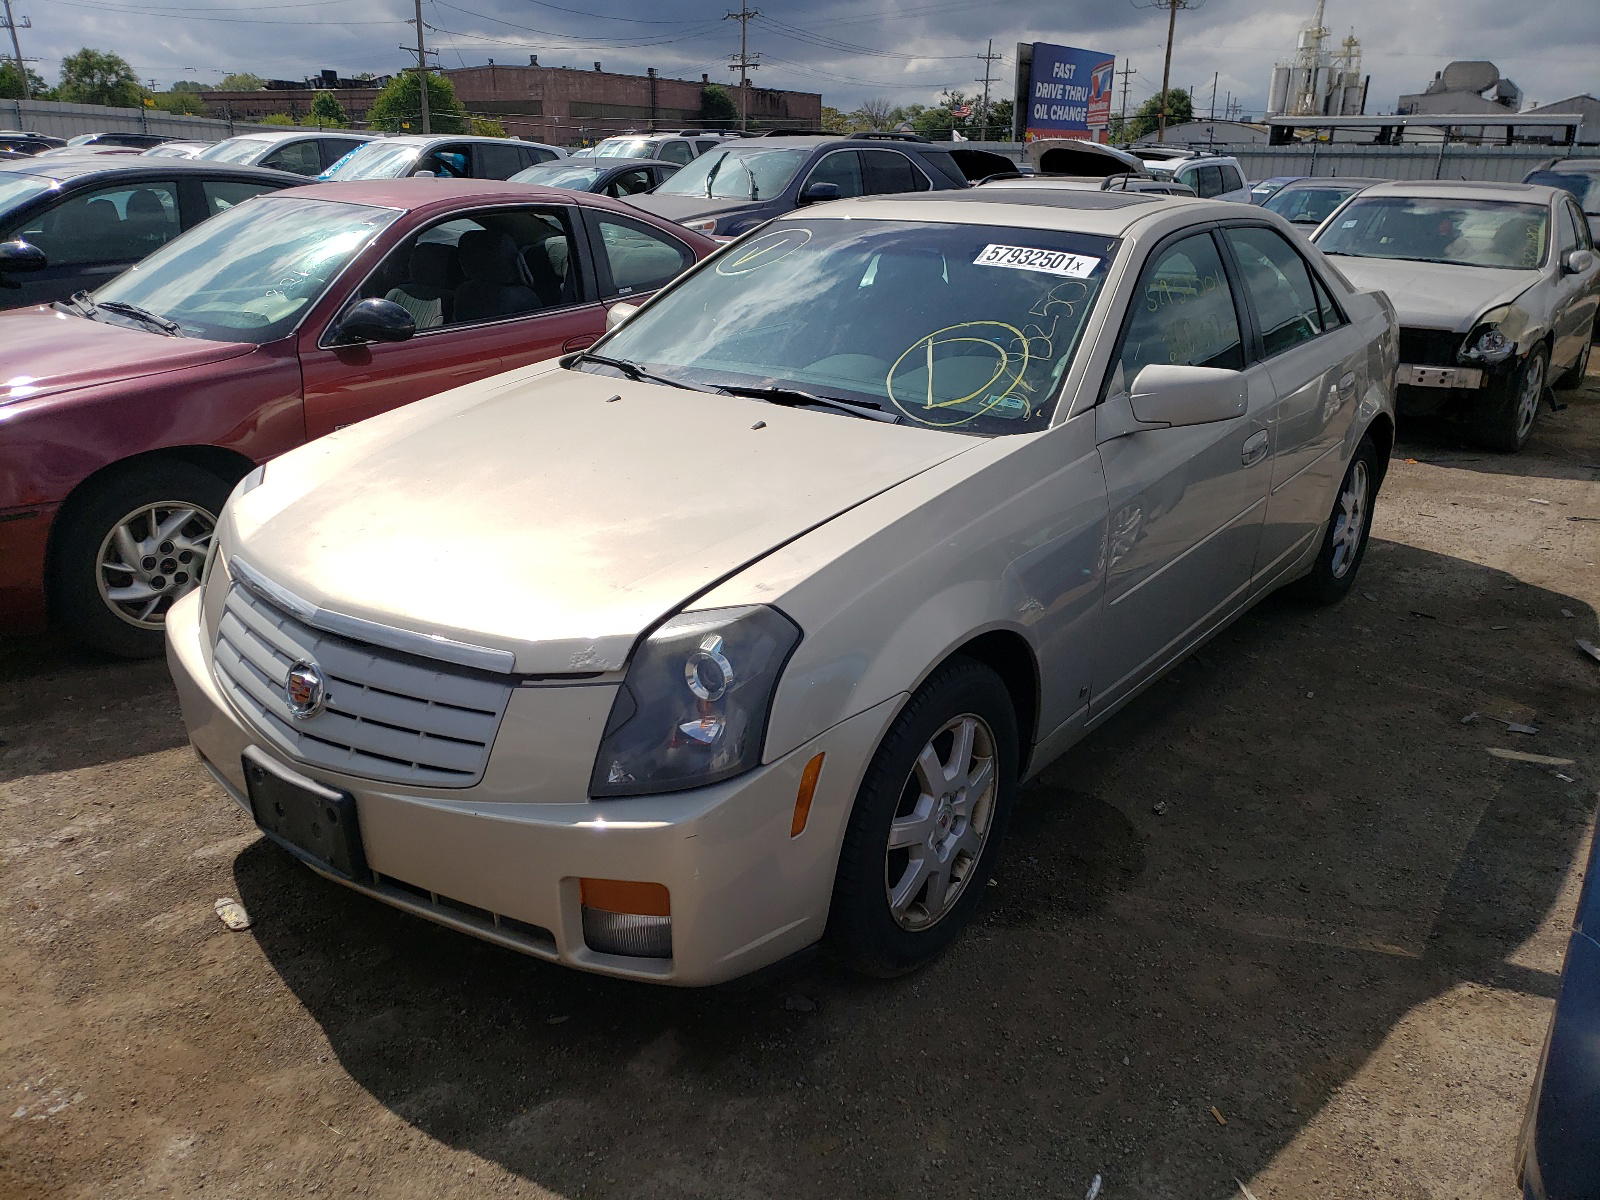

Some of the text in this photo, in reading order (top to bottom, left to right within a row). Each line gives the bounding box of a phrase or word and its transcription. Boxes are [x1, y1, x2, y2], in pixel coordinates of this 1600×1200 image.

[1053, 62, 1076, 79] FAST
[1035, 82, 1089, 102] DRIVE THRU
[1033, 104, 1048, 119] OIL
[1050, 105, 1087, 122] CHANGE
